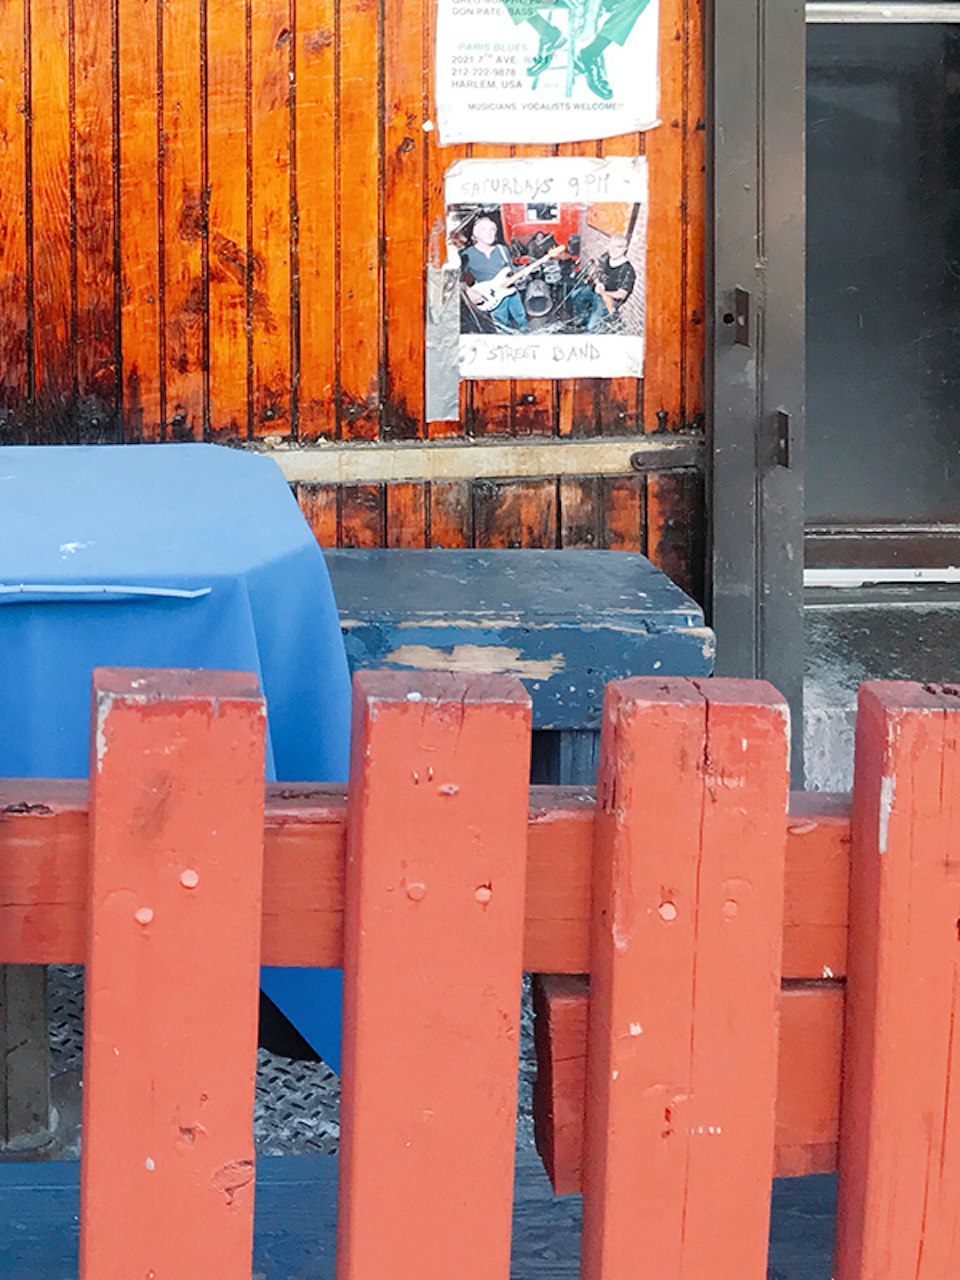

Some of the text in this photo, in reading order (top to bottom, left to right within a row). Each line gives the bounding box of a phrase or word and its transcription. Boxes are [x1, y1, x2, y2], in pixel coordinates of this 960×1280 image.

[451, 7, 474, 17] DON
[458, 42, 528, 52] PARIS BLUES
[451, 55, 474, 65] 2021
[501, 79, 523, 89] USA
[521, 102, 572, 111] VOCALISTS
[460, 175, 554, 201] SATURDAYS
[486, 344, 541, 363] STREET
[551, 342, 602, 363] BAND
